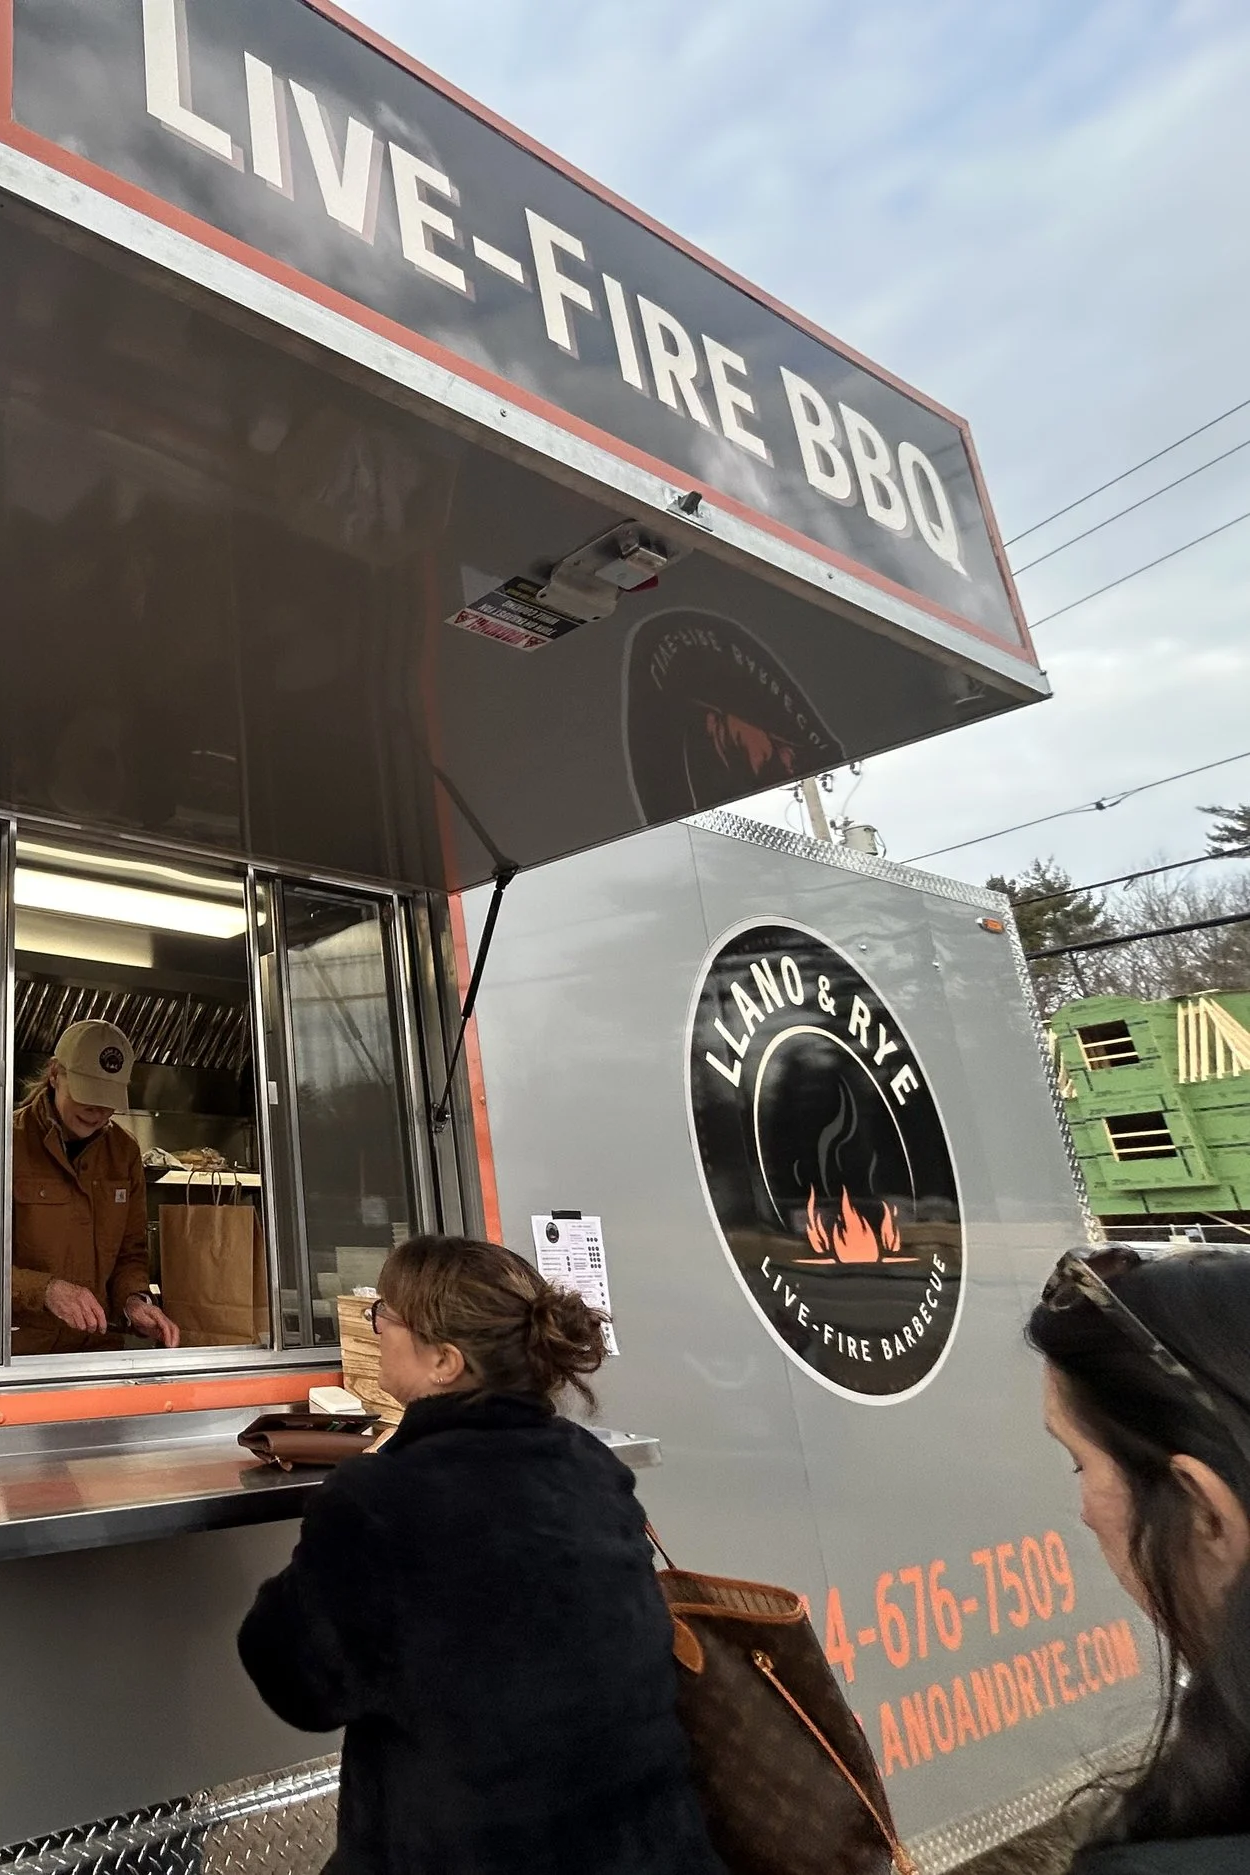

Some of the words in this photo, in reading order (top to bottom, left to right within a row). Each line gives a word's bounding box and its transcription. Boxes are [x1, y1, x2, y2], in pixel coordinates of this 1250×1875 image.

[143, 0, 770, 461] LIVE-FIRE
[780, 366, 968, 577] BBQ
[705, 955, 804, 1088] LLANO
[817, 975, 836, 1016] &
[848, 994, 919, 1107] RYE
[760, 1256, 873, 1363] LIVE-FIRE
[881, 1253, 946, 1362] BARBECUE
[801, 1529, 1076, 1684] 4-676-7509
[854, 1618, 1141, 1778] ANOANDRYE.COM
